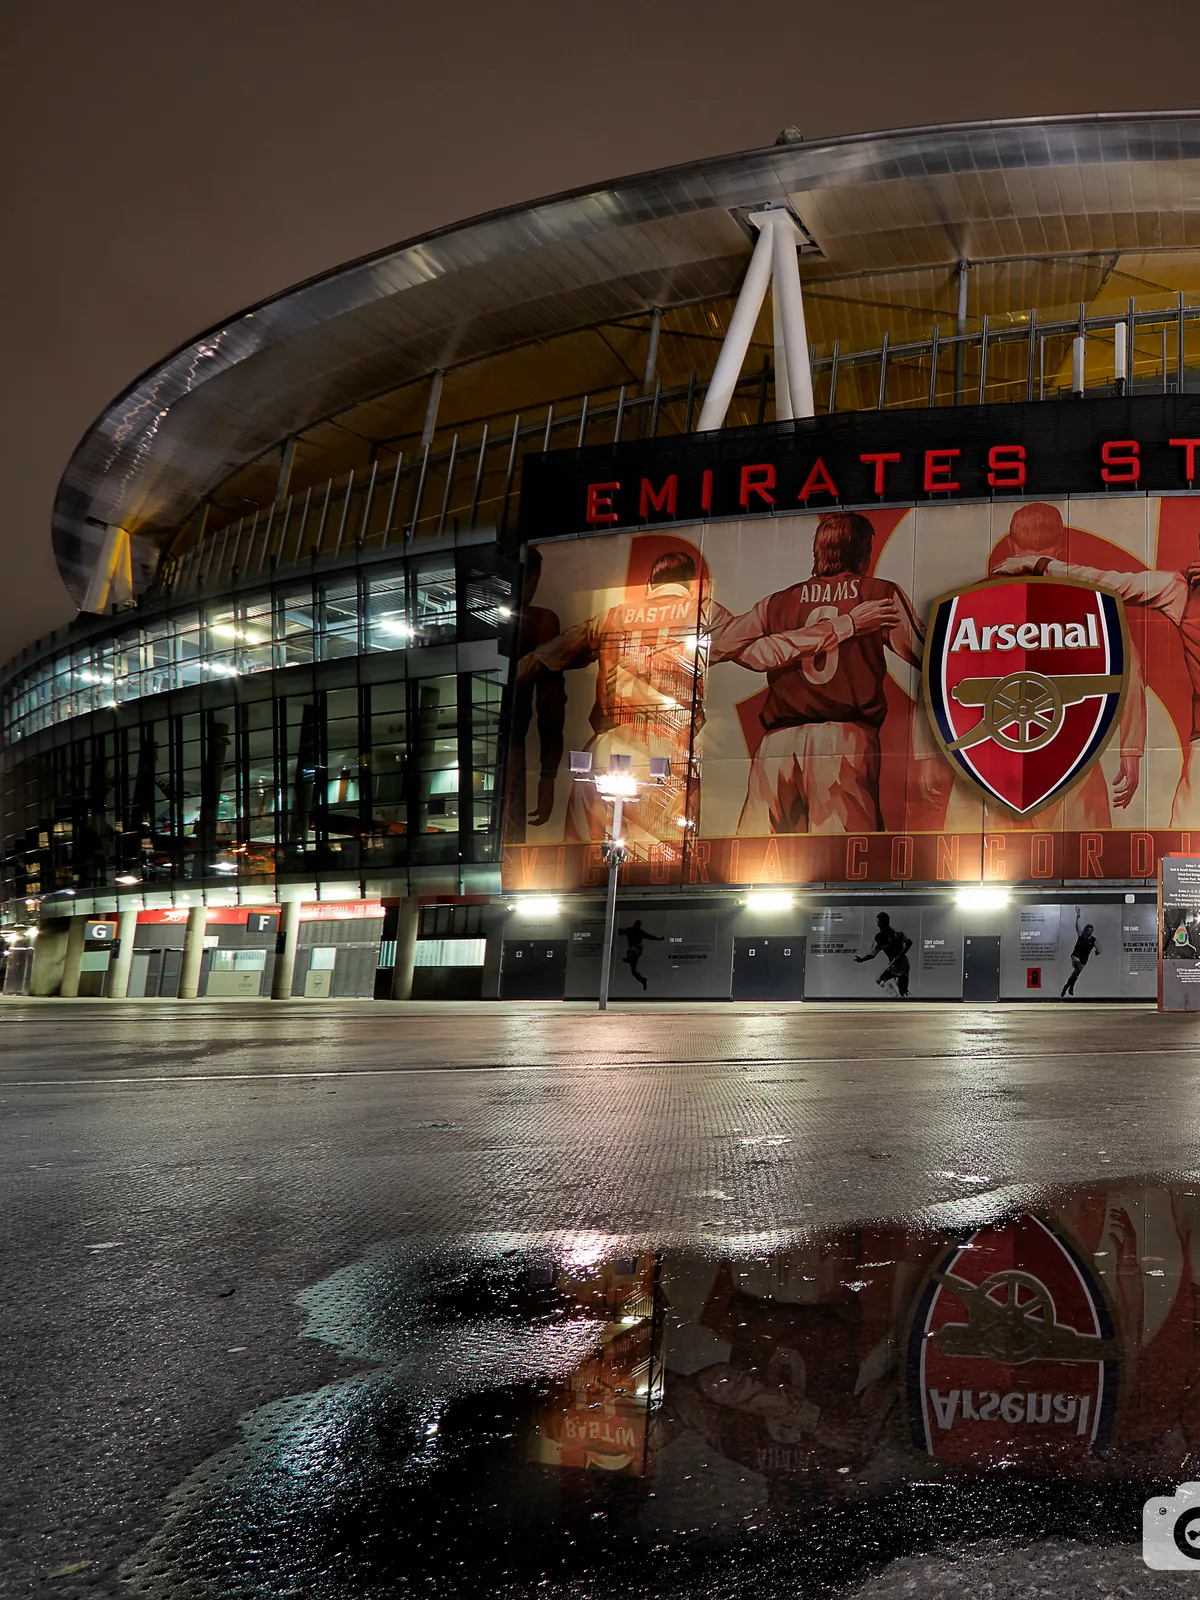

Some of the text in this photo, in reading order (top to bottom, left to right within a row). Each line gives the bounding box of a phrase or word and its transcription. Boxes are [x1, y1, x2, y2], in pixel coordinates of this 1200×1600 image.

[586, 445, 1027, 524] EMIRATES
[800, 579, 860, 605] ADAMS
[624, 602, 691, 626] BASTIN
[951, 613, 1101, 653] Arsenal
[92, 924, 107, 939] G
[258, 915, 270, 931] F
